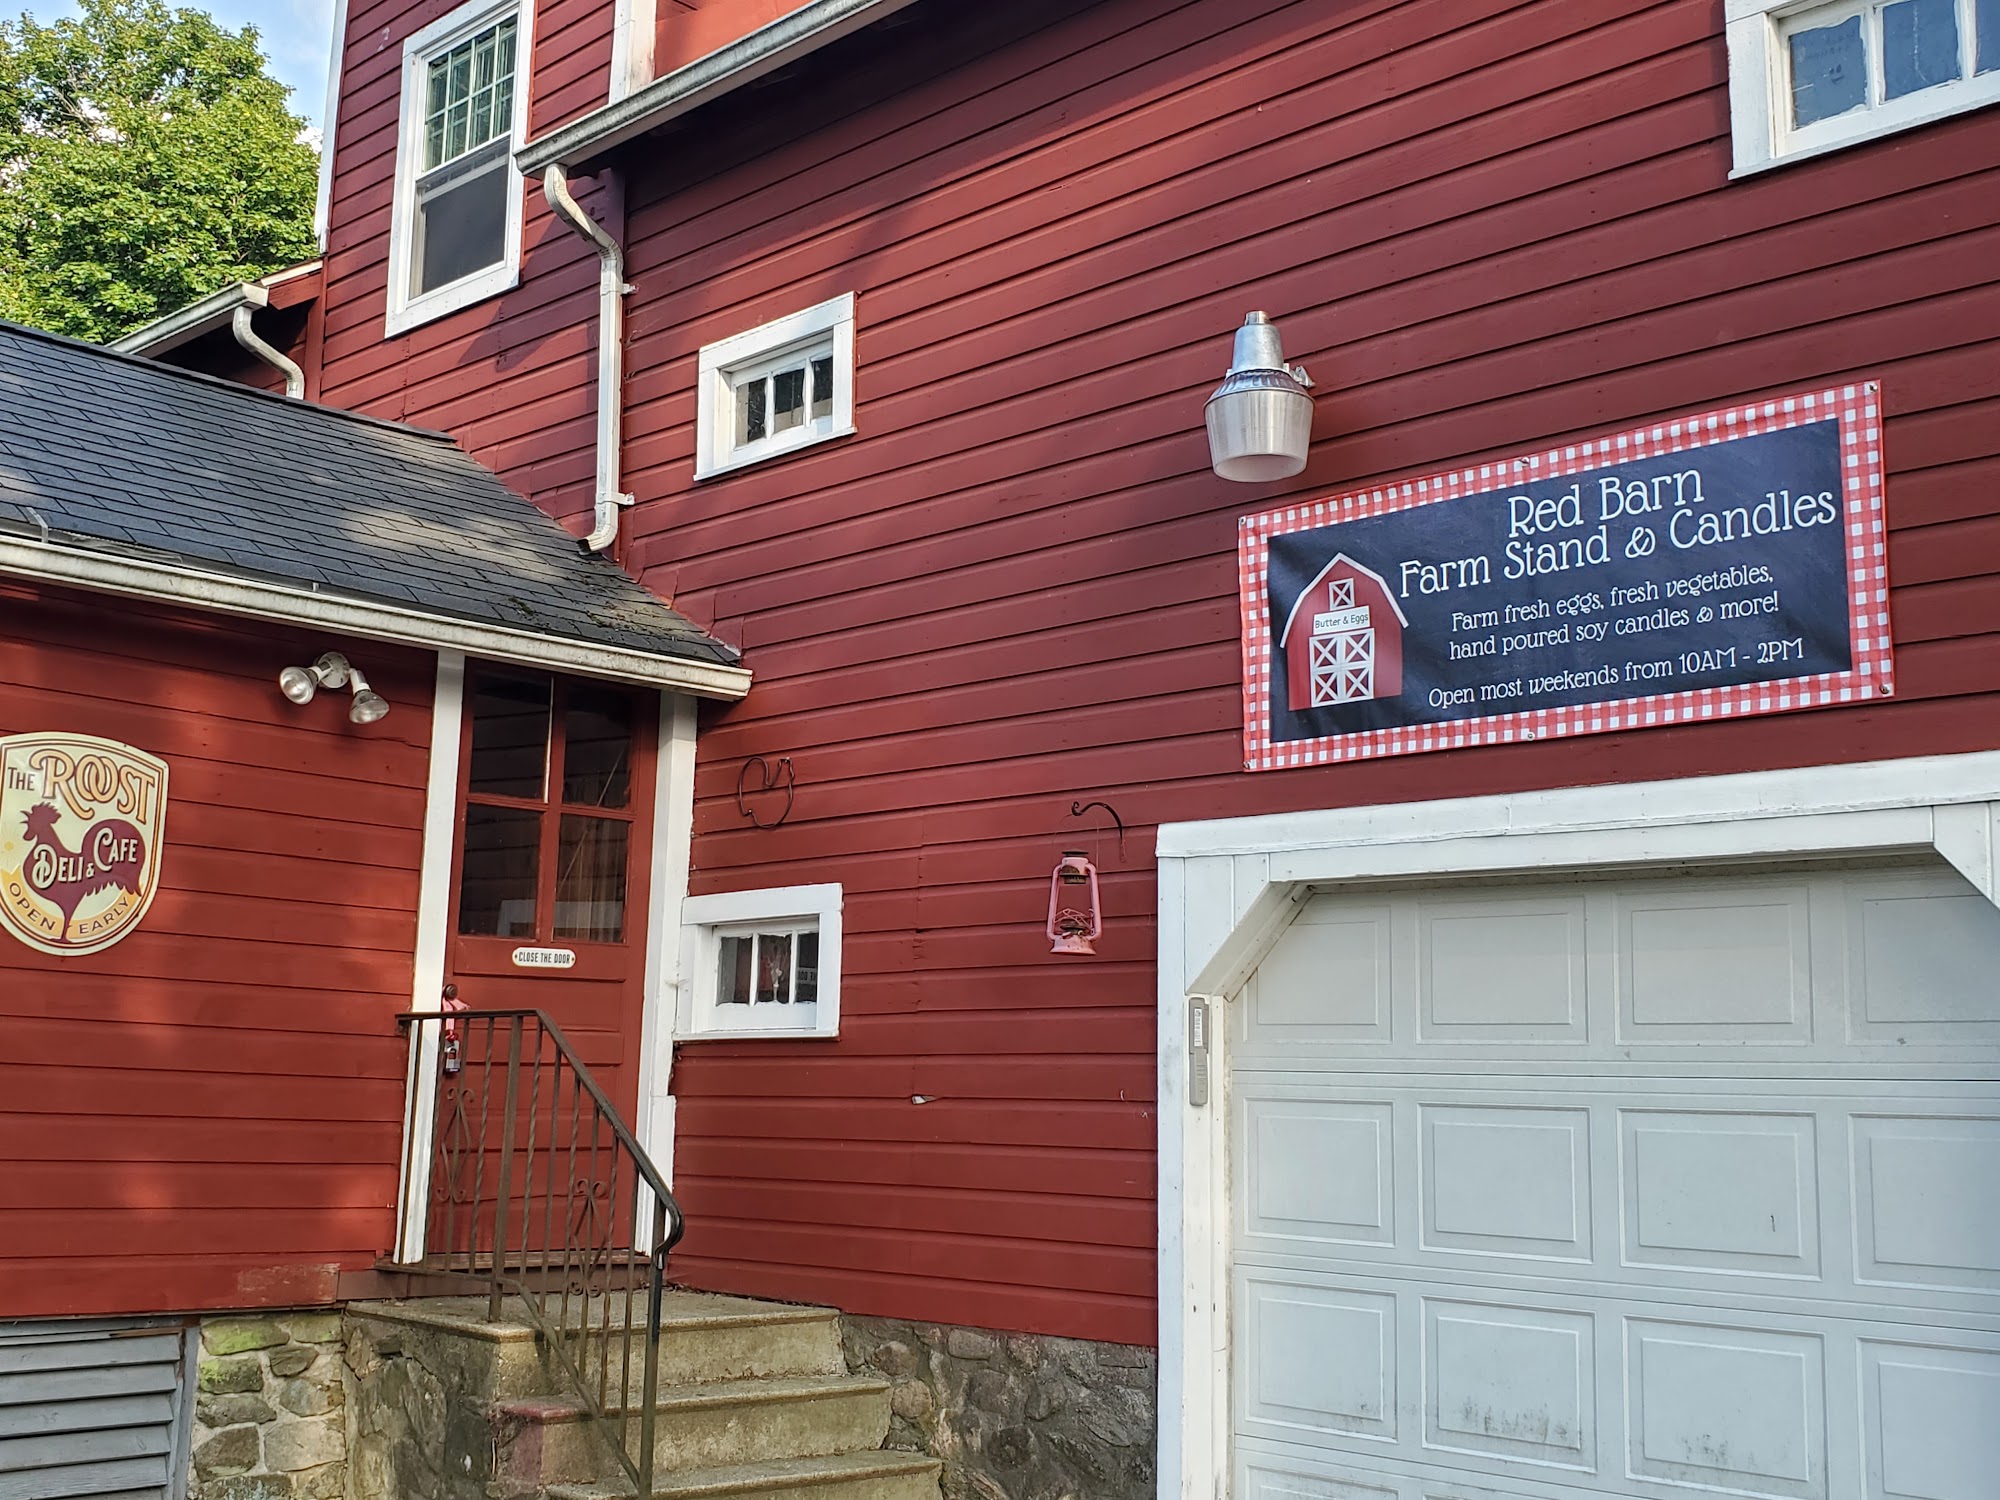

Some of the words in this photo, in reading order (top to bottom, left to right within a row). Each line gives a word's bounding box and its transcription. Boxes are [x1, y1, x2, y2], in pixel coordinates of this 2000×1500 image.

[1508, 484, 1584, 538] Red
[1599, 469, 1704, 520] Barn
[1400, 555, 1491, 598] Farm
[1503, 525, 1611, 579] Stand
[1625, 526, 1656, 559] &
[1670, 490, 1836, 549] Candles
[1315, 618, 1341, 629] Butter
[1342, 616, 1349, 625] &
[1350, 614, 1369, 625] Eggs
[1449, 635, 1496, 660] hand
[1502, 624, 1570, 656] poured
[1576, 621, 1609, 642] soy
[1615, 608, 1690, 636] candles
[1696, 606, 1714, 624] &
[1720, 590, 1779, 620] more!
[1452, 610, 1499, 632] Farm
[1504, 599, 1550, 624] fresh
[1556, 592, 1604, 616] eggs,
[1610, 581, 1659, 607] fresh
[1666, 565, 1774, 597] vegetables,
[1428, 687, 1475, 709] Open
[1480, 678, 1523, 701] most
[1529, 665, 1619, 695] weekends
[1624, 659, 1674, 682] from
[1678, 646, 1737, 675] 10AM
[1757, 638, 1804, 664] 2PM
[8, 767, 36, 792] THE
[29, 748, 156, 826] ROOST
[32, 843, 83, 889] DELI
[86, 863, 95, 878] &
[94, 827, 139, 872] CAFE
[9, 882, 56, 931] OPEN
[79, 896, 130, 935] EARLY
[518, 951, 539, 963] CLOSE
[540, 952, 552, 963] THE
[553, 953, 571, 964] DOOR
